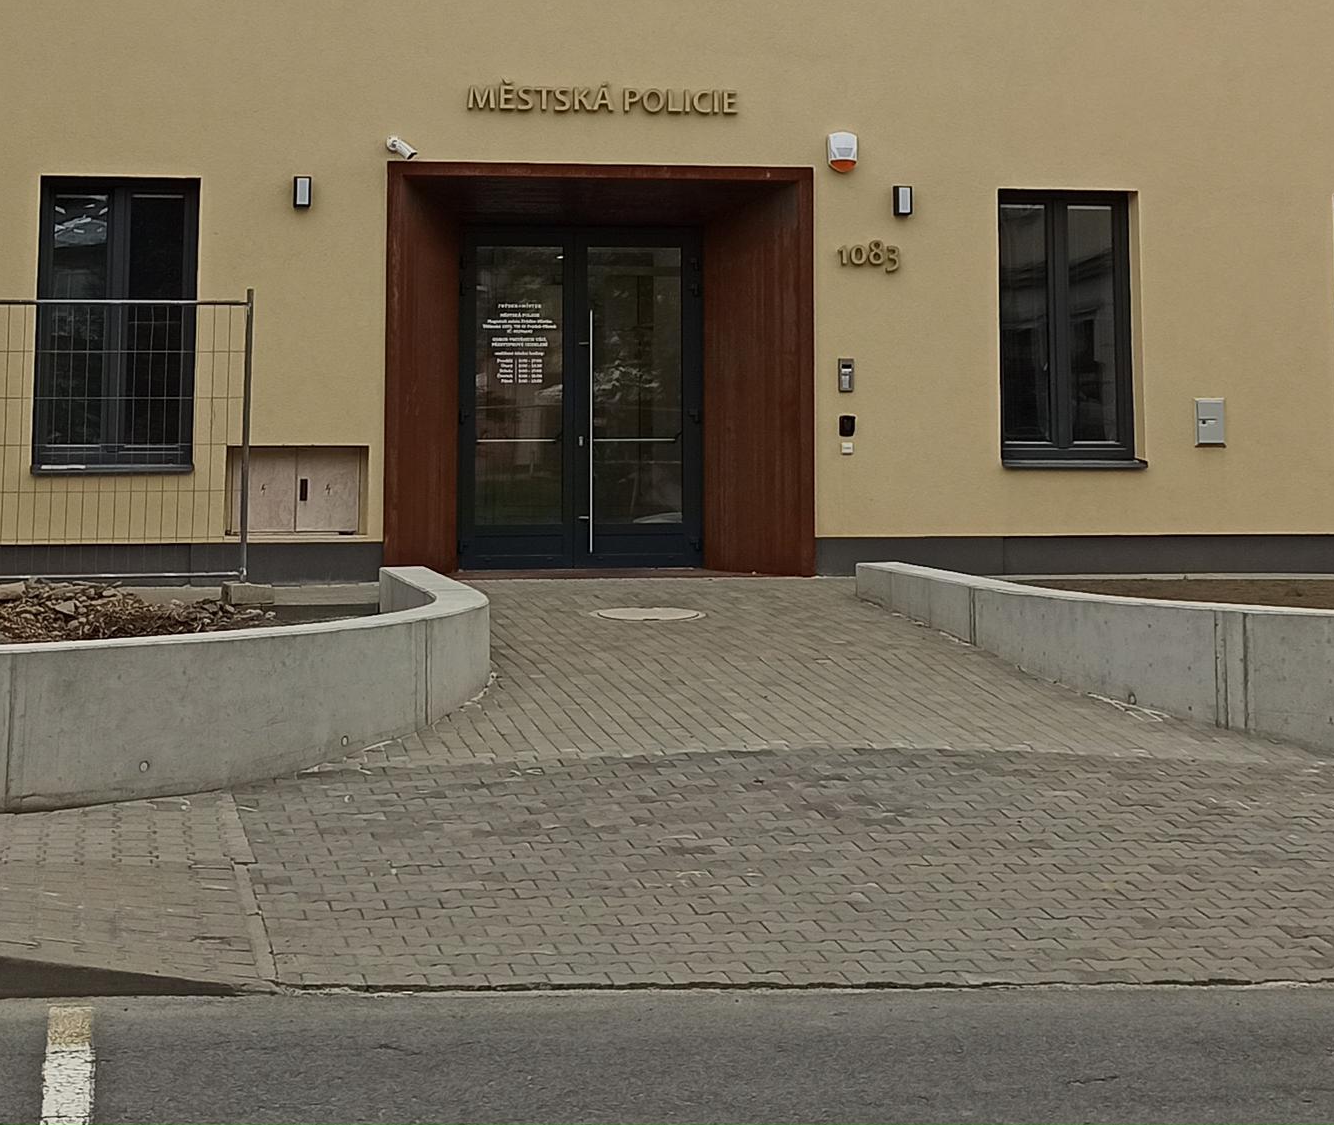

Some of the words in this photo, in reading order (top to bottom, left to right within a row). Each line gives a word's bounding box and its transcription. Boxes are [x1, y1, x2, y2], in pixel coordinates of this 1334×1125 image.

[467, 78, 614, 114] MĚSTSKÁ
[623, 87, 739, 116] POLICIE
[837, 239, 900, 273] 1083
